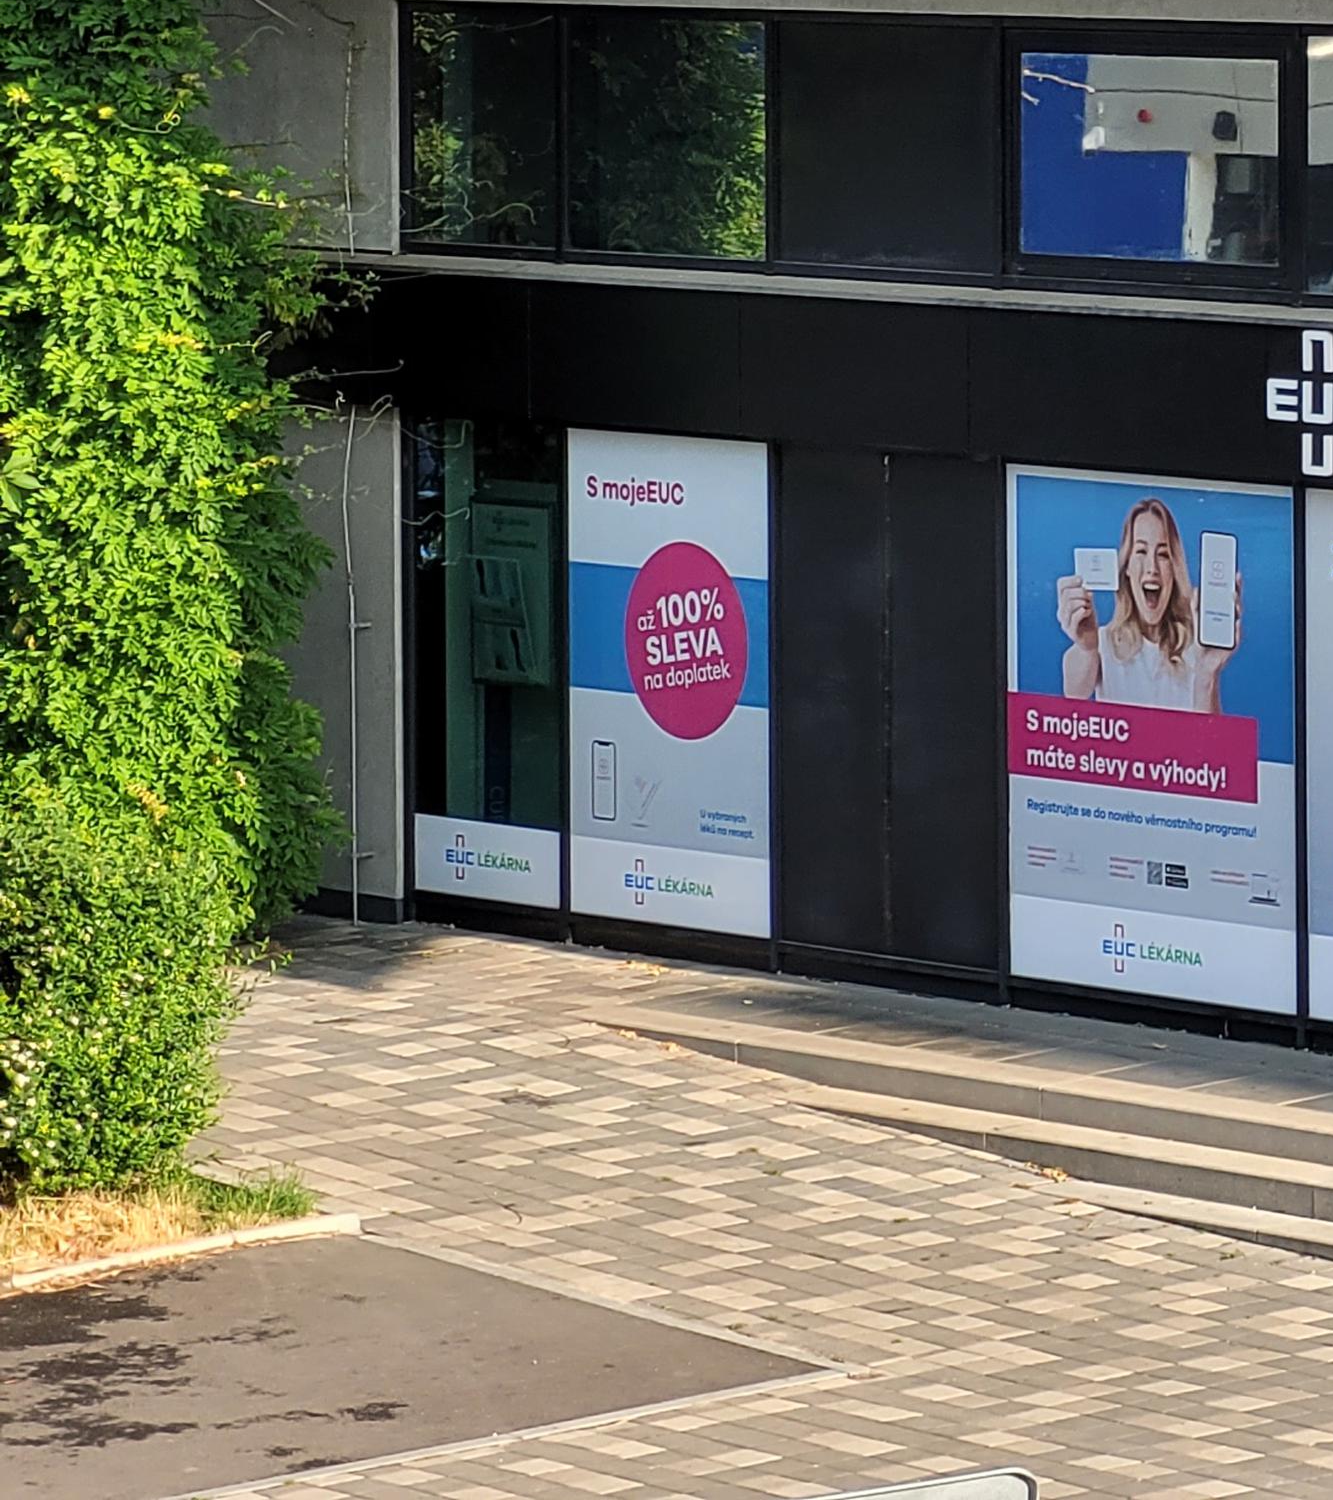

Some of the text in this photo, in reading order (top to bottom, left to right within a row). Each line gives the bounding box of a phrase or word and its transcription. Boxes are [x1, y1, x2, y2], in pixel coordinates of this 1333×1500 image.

[586, 475, 685, 507] S mojeEUC
[637, 586, 724, 632] až 100%
[645, 625, 724, 666] SLEVA
[643, 659, 731, 691] na doplatek
[1026, 709, 1130, 742] S mojeEUC
[1026, 745, 1227, 791] máte slevy a výhody!
[1027, 798, 1257, 838] Registrujte se do nového věrnostního programu!
[445, 849, 532, 874] EUC LÉKÁRNA
[624, 873, 714, 899] EUC LÉKÁRNA
[1102, 939, 1203, 967] EUC LÉKÁRNA
